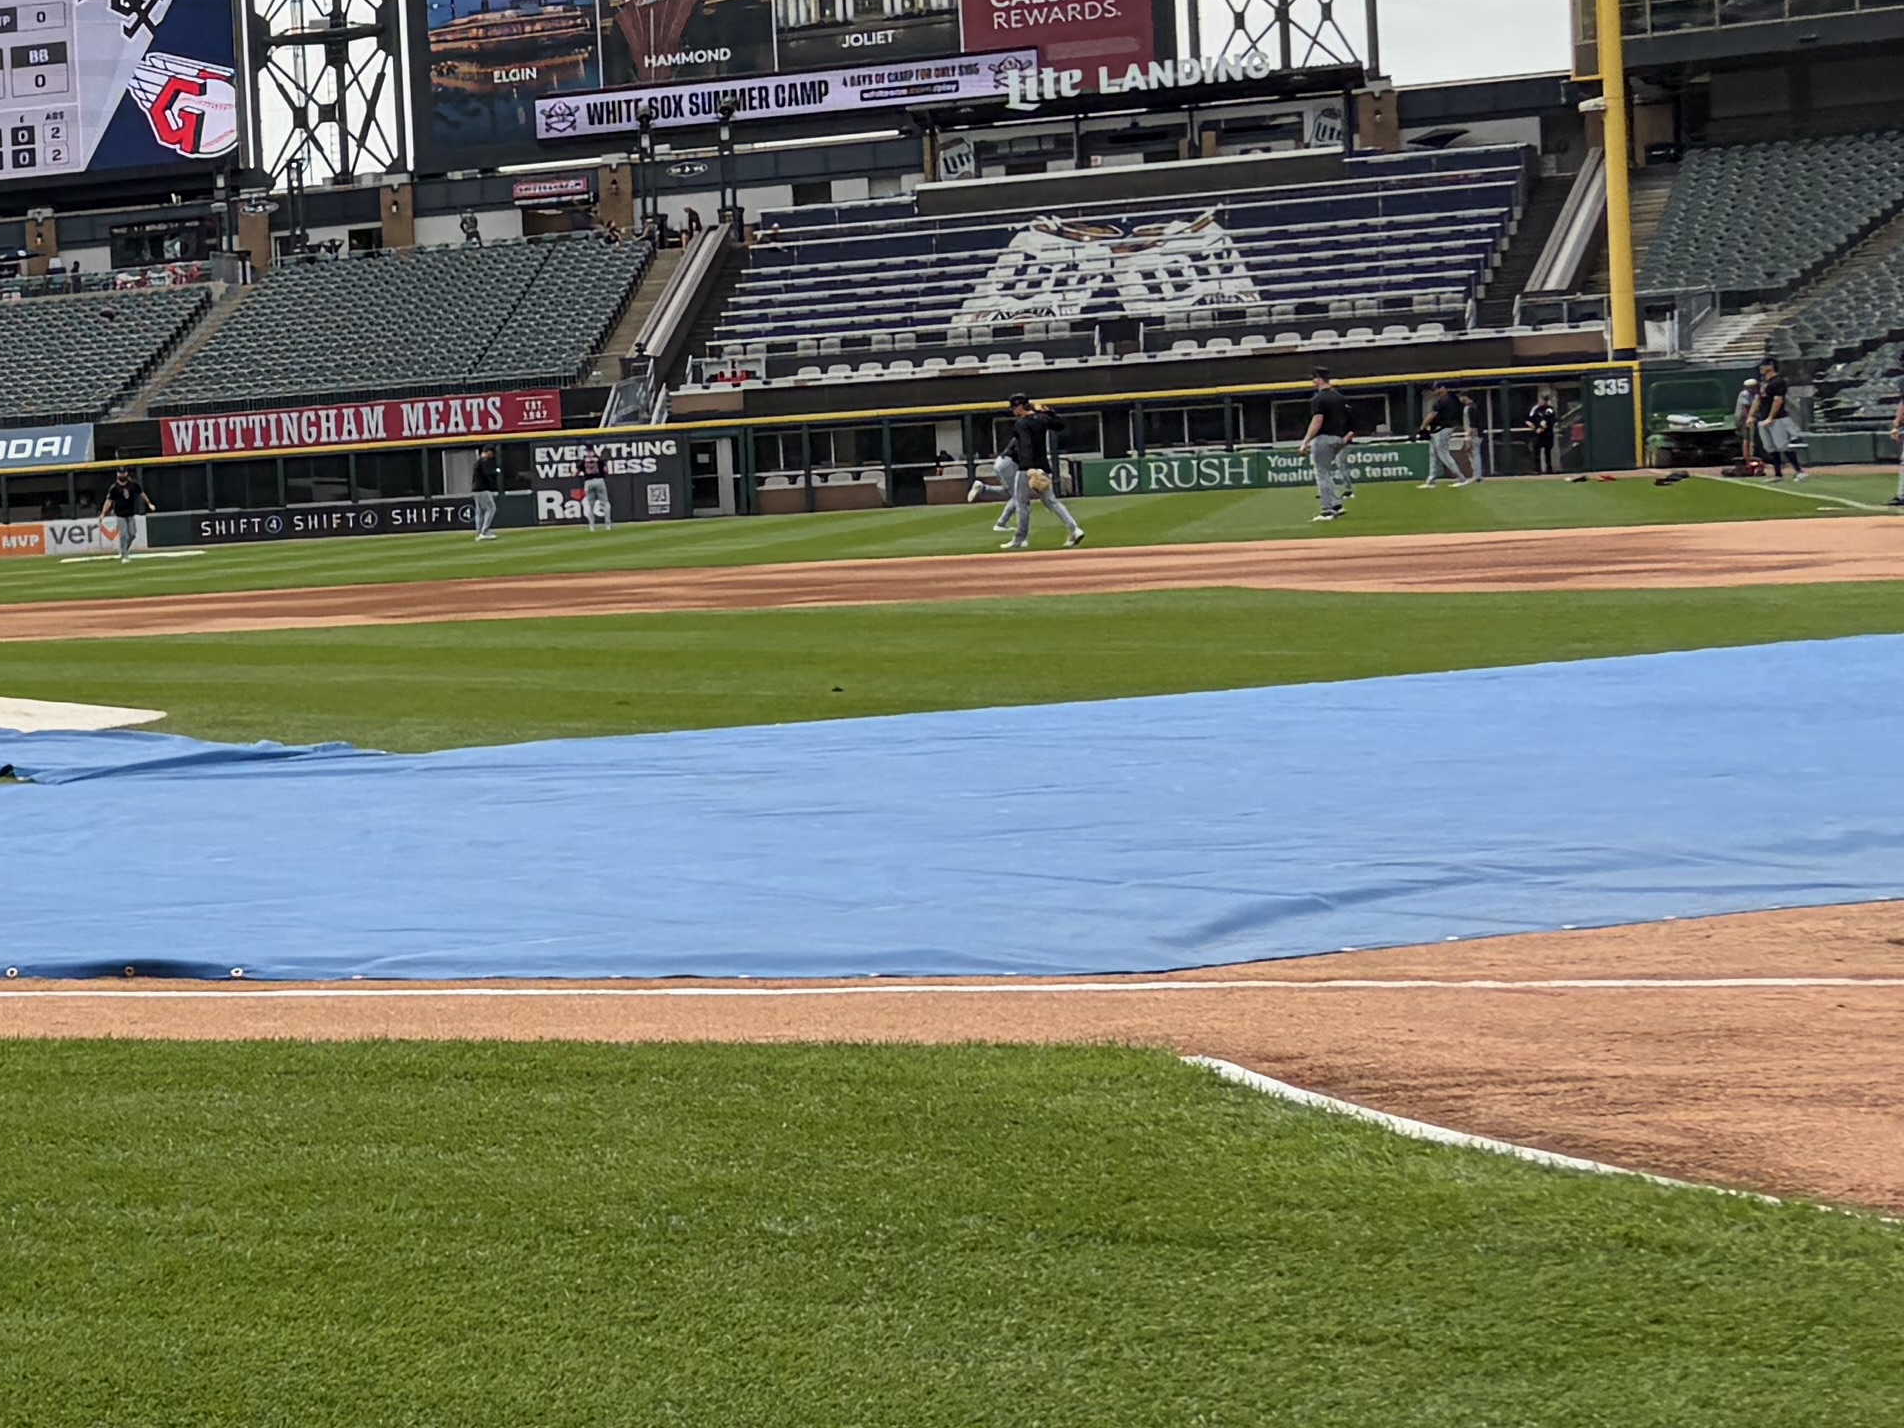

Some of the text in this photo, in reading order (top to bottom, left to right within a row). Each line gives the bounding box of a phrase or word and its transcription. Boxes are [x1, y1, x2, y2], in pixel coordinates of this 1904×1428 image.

[36, 11, 46, 24] 0
[993, 0, 1122, 29] REWARDS.
[841, 30, 894, 48] JOLIET
[29, 49, 49, 63] BB
[644, 47, 732, 68] HAMMOND
[34, 75, 46, 88] 0
[493, 67, 537, 84] ELGIN
[1004, 50, 1272, 111] Lite LANDING
[647, 94, 685, 120] SOX
[775, 80, 829, 107] CAMP
[18, 129, 29, 143] 0
[51, 127, 61, 139] 2
[19, 151, 30, 165] 0
[52, 149, 62, 161] 2
[1593, 378, 1630, 396] 335
[169, 397, 504, 453] WHITTINGHAM MEATS
[1267, 456, 1306, 468] Your
[1148, 457, 1253, 490] RUSH
[1365, 465, 1413, 478] team.
[2, 533, 40, 549] MVP
